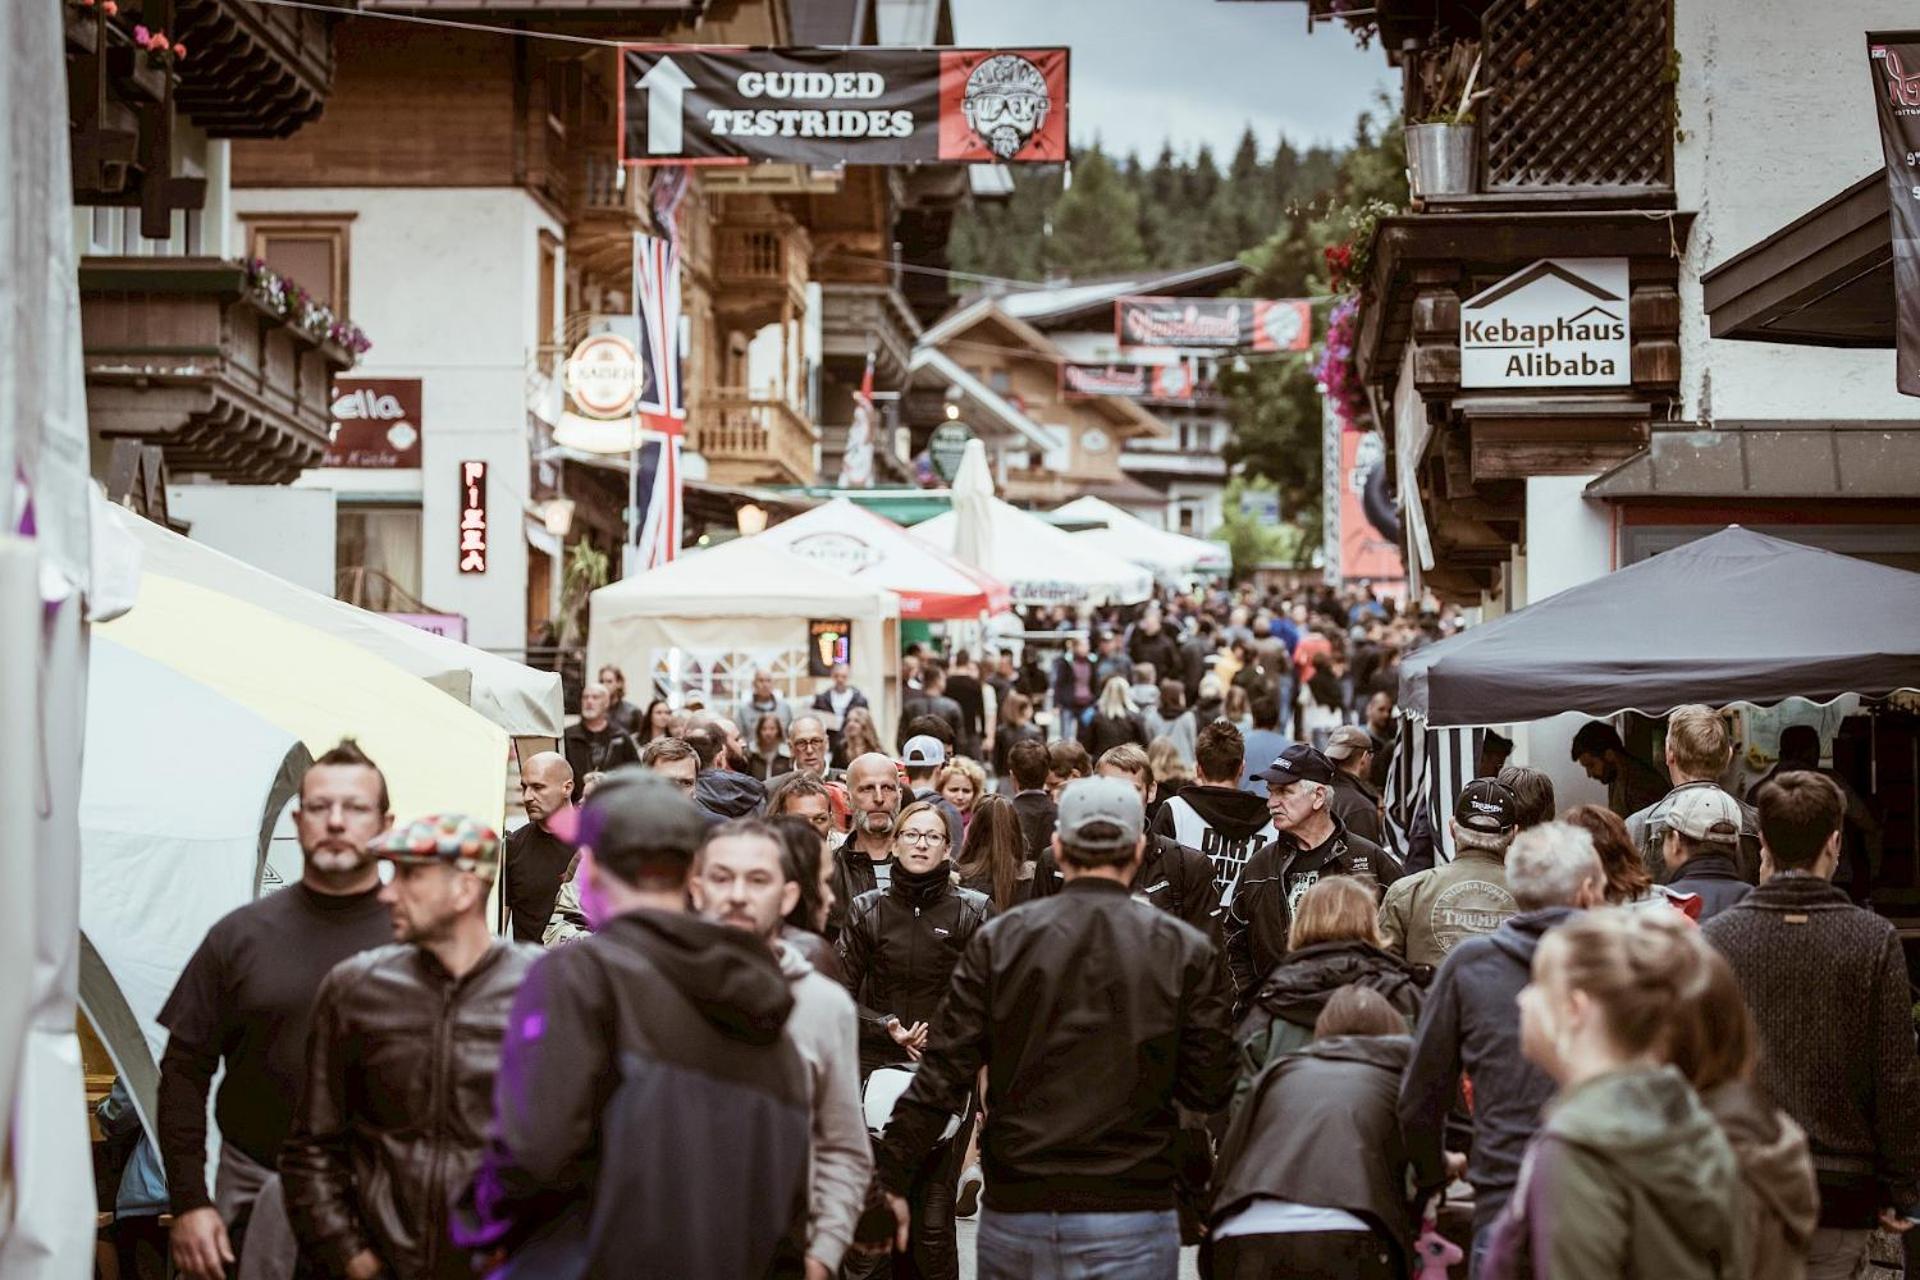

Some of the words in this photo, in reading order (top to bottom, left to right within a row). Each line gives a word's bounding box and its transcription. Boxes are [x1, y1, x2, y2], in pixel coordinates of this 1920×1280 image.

[737, 71, 885, 99] GUIDED
[706, 109, 915, 138] TESTRIDES
[1464, 317, 1626, 348] Kebaphaus
[1505, 352, 1615, 377] Alibaba
